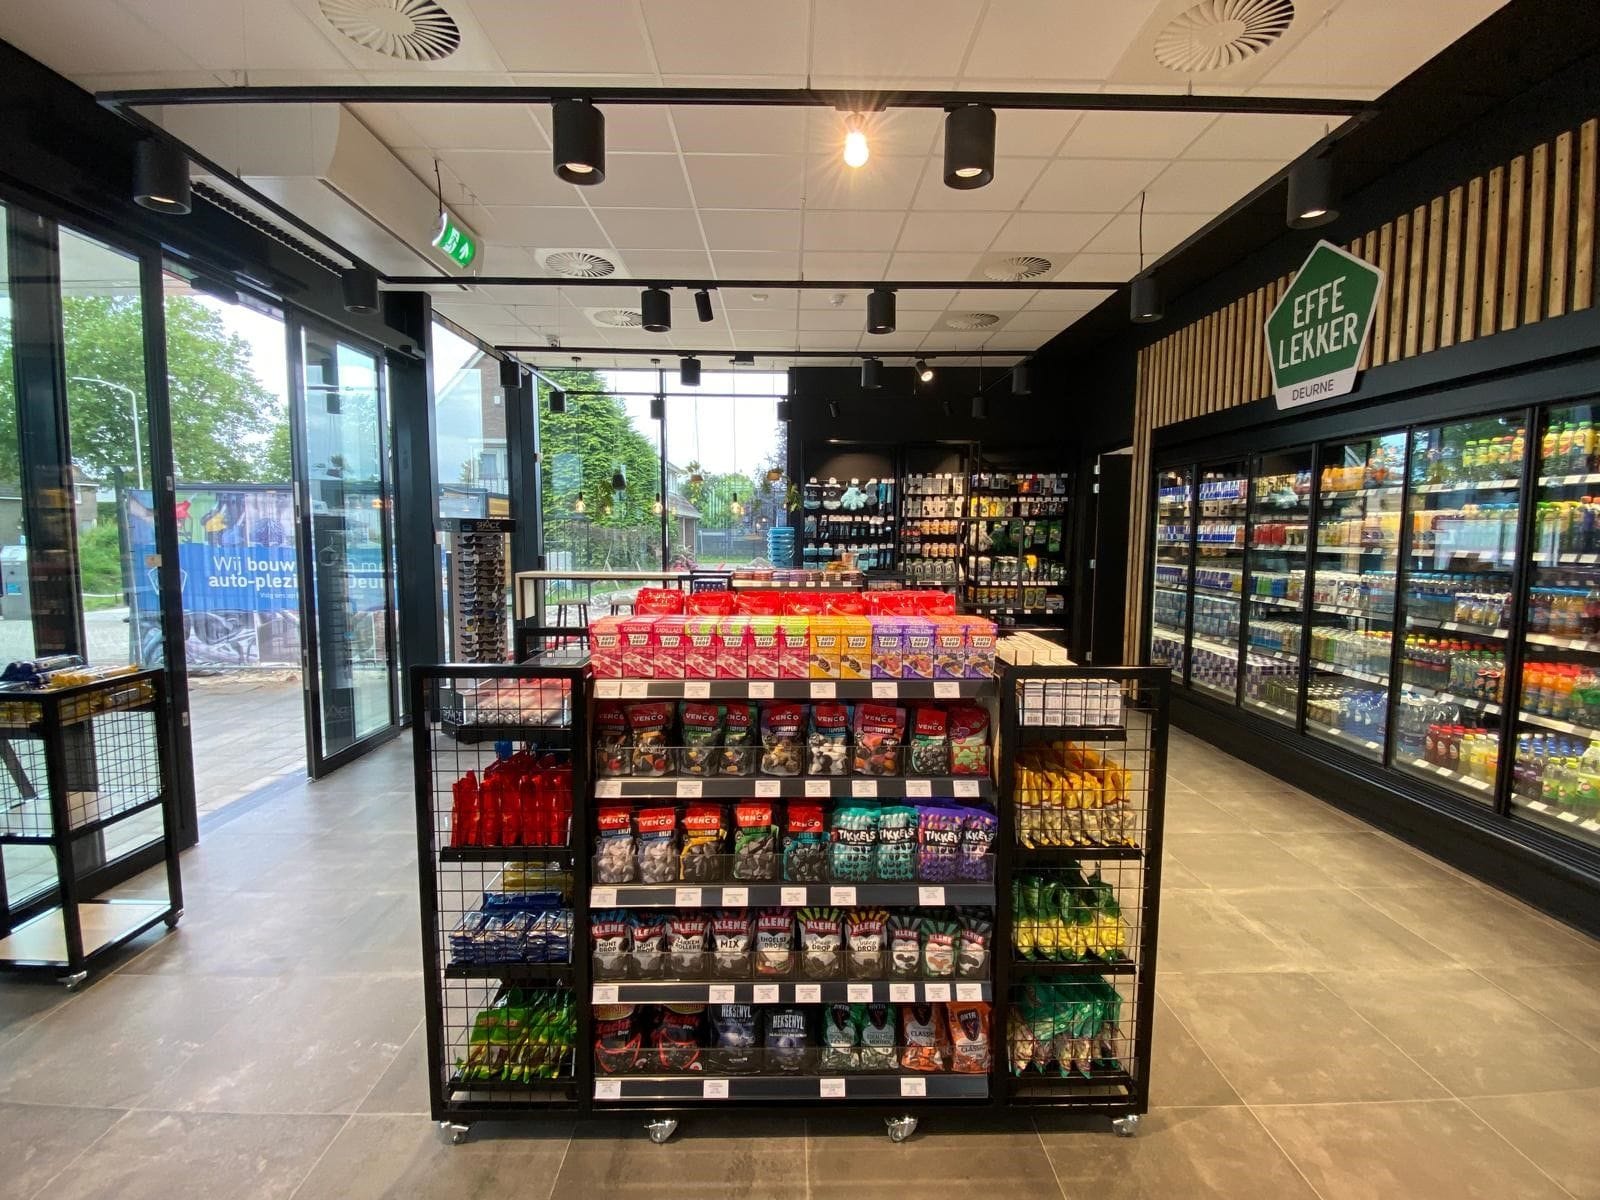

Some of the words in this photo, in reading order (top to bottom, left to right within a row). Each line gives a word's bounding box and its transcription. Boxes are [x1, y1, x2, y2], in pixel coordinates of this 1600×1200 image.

[1293, 275, 1346, 329] EFFE
[1278, 312, 1358, 370] LEKKER
[1291, 379, 1335, 401] DEURNE
[213, 555, 242, 575] Wij
[247, 556, 295, 572] bouw
[633, 714, 664, 722] VENCO
[686, 713, 715, 721] VENCO
[864, 714, 894, 723] VENCO
[918, 723, 943, 731] VENCO
[641, 818, 672, 827] VENCO
[687, 815, 718, 824] VENCO
[838, 829, 876, 843] TIKKELS
[674, 921, 704, 931] KLENE
[714, 920, 747, 930] KLENE
[758, 917, 790, 928] KLENE
[807, 920, 837, 931] KLENE
[852, 921, 882, 932] KLENE
[592, 923, 625, 935] KLENE
[895, 930, 918, 938] KLENE
[929, 933, 953, 943] KLENE
[720, 939, 739, 949] MIX
